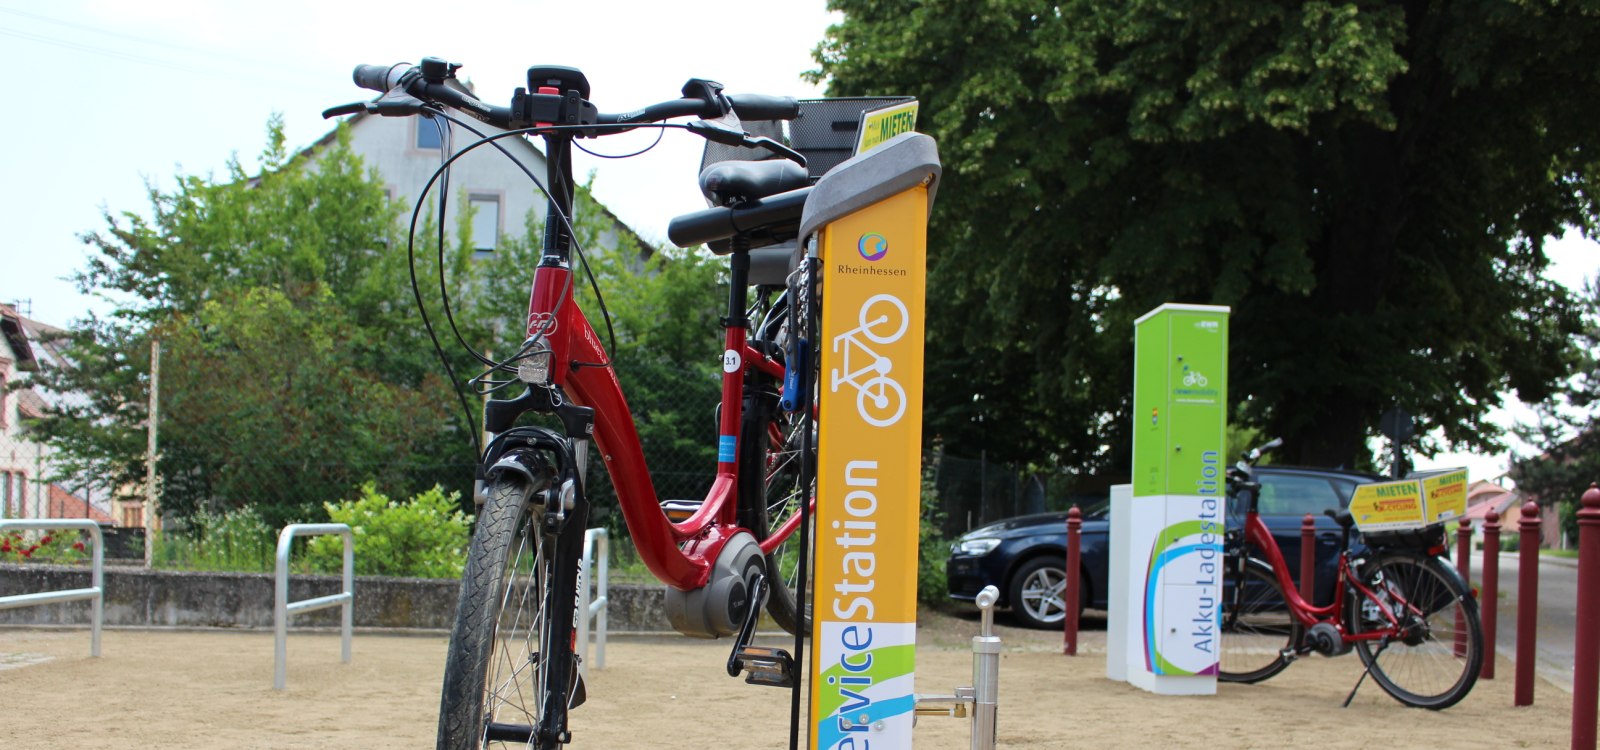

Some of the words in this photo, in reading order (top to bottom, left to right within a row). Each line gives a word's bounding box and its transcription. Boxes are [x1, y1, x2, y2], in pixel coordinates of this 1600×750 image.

[880, 111, 914, 141] MIETEN
[838, 265, 906, 276] Rheinhessen
[725, 356, 736, 365] 3.1
[1439, 472, 1467, 485] MIETEN
[1376, 483, 1417, 497] MIETEN
[1192, 450, 1218, 653] Akku-Ladestation
